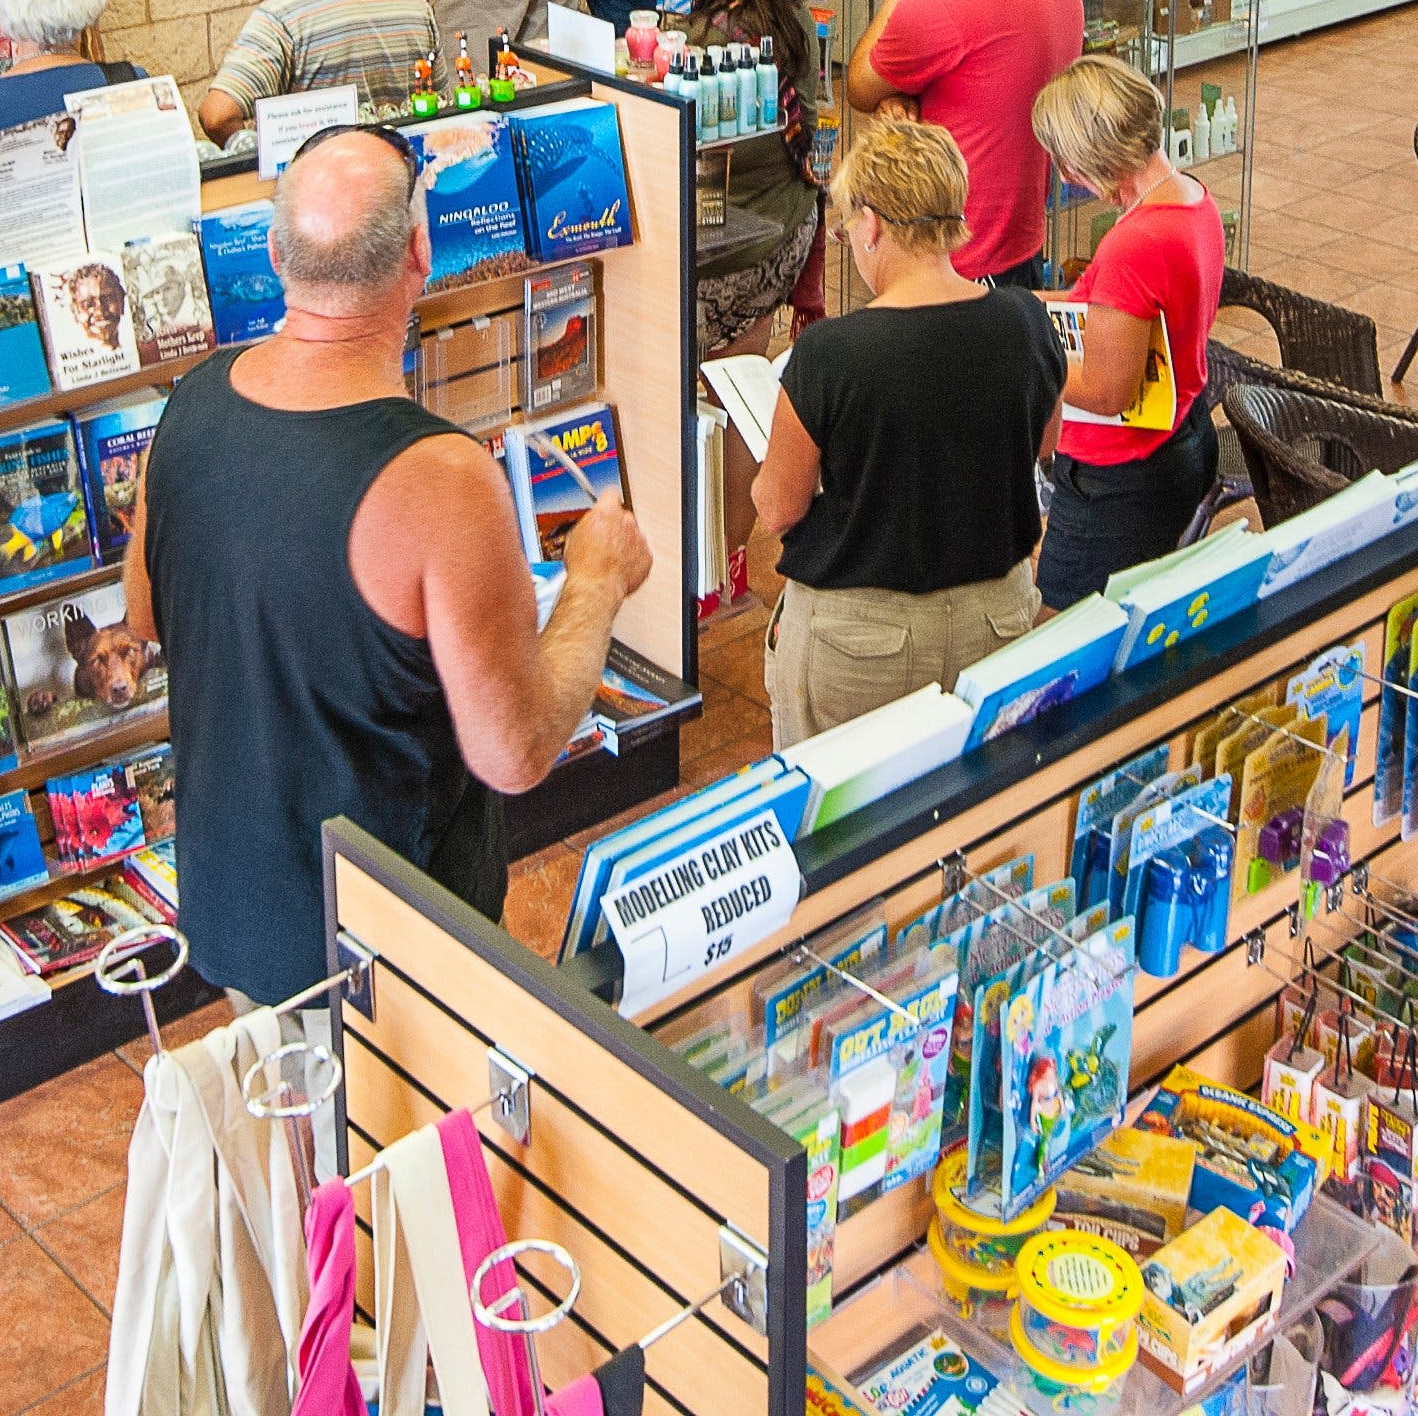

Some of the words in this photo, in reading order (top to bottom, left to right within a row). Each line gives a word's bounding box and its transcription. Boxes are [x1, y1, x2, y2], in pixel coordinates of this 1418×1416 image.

[267, 111, 288, 121] Please
[291, 109, 301, 118] ask
[303, 107, 313, 115] for
[314, 102, 347, 114] assistance
[474, 226, 486, 235] on
[547, 197, 622, 240] Exmouth
[60, 346, 95, 362] Wishes
[62, 363, 79, 376] For
[81, 351, 126, 372] Starlight
[106, 432, 135, 448] CORAL
[614, 859, 705, 928] MODELLING
[701, 838, 743, 881] CLAY
[739, 821, 782, 861] KITS
[701, 875, 772, 935] REDUCED
[704, 932, 734, 966] $15
